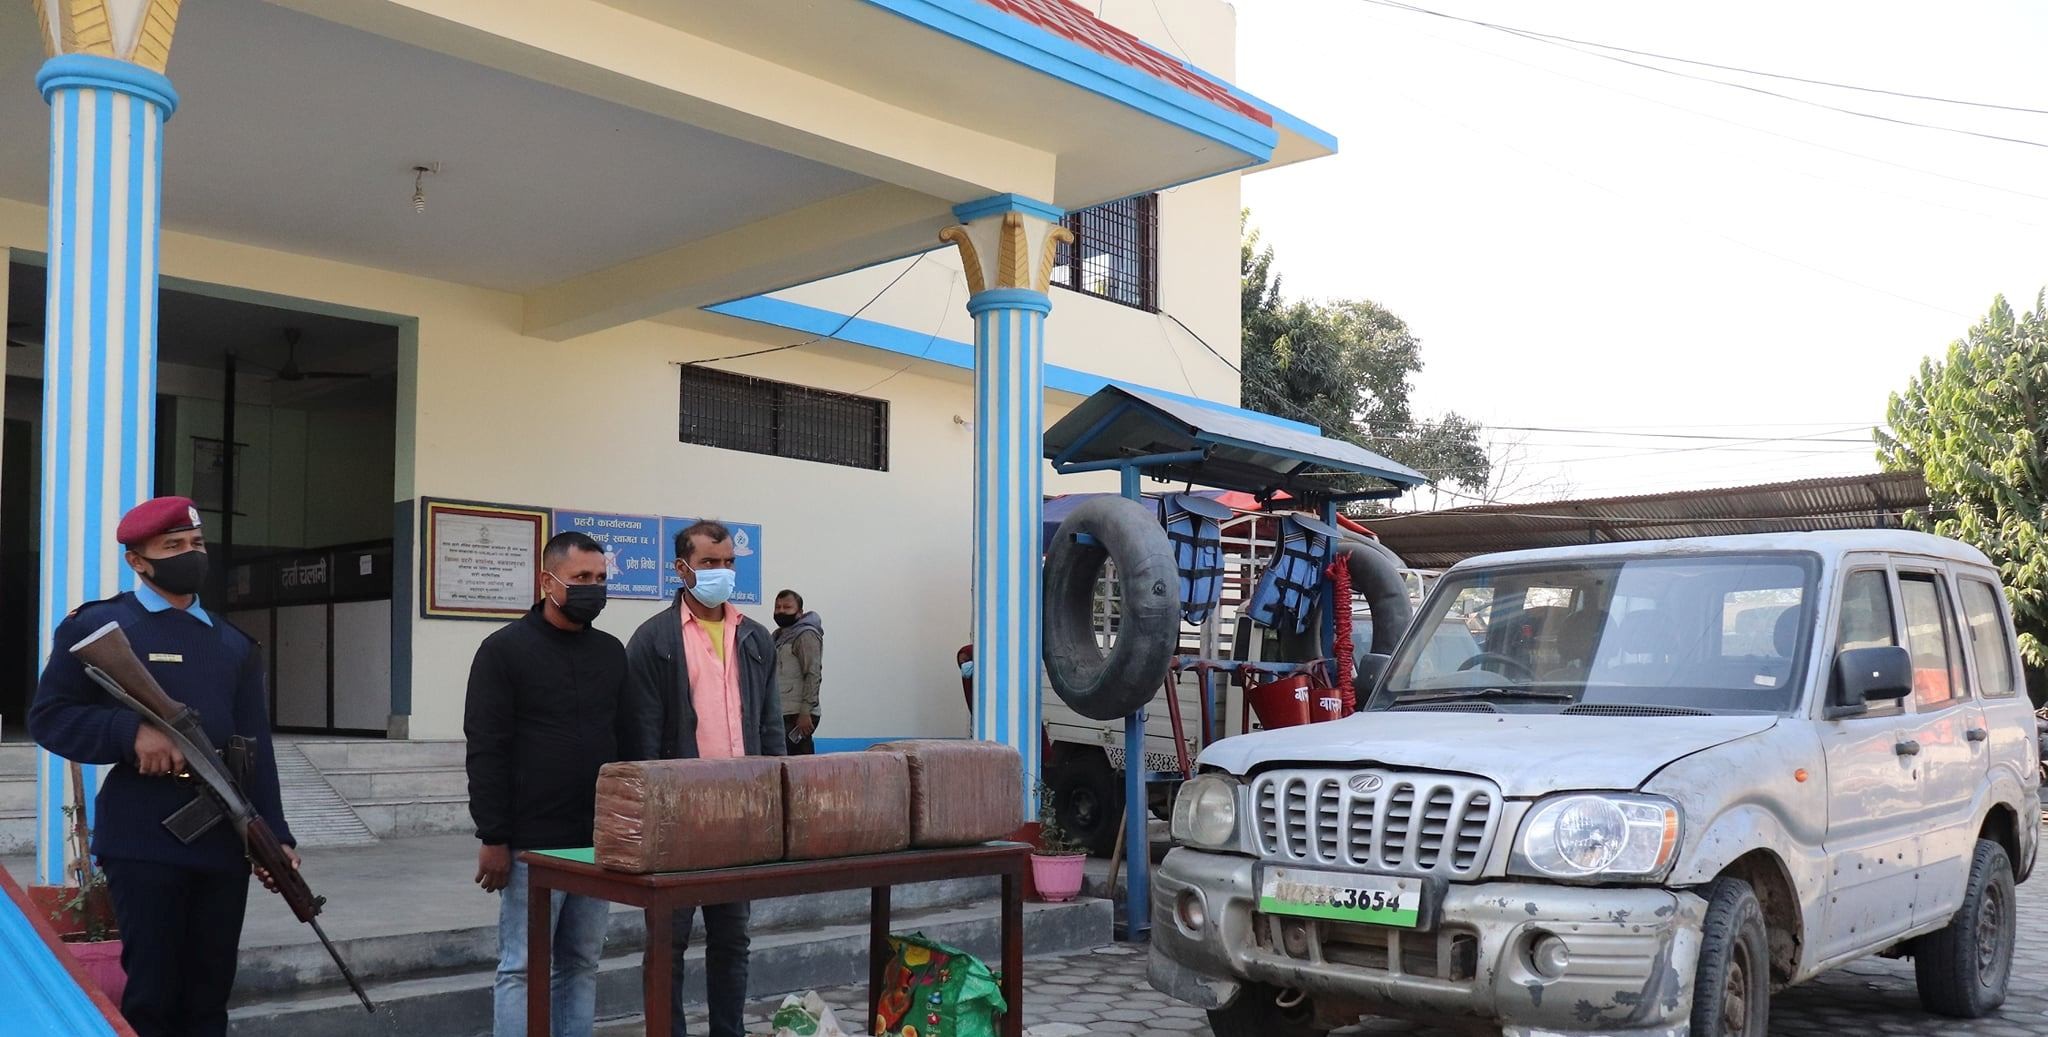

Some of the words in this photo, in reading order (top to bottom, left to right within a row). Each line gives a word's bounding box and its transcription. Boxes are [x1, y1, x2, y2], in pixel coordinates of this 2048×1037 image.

[574, 516, 594, 527] प्रहरी
[597, 519, 642, 529] कार्यालयमा
[613, 534, 637, 544] स्वागत
[282, 560, 298, 587] दर्ता
[300, 557, 327, 585] चलानी
